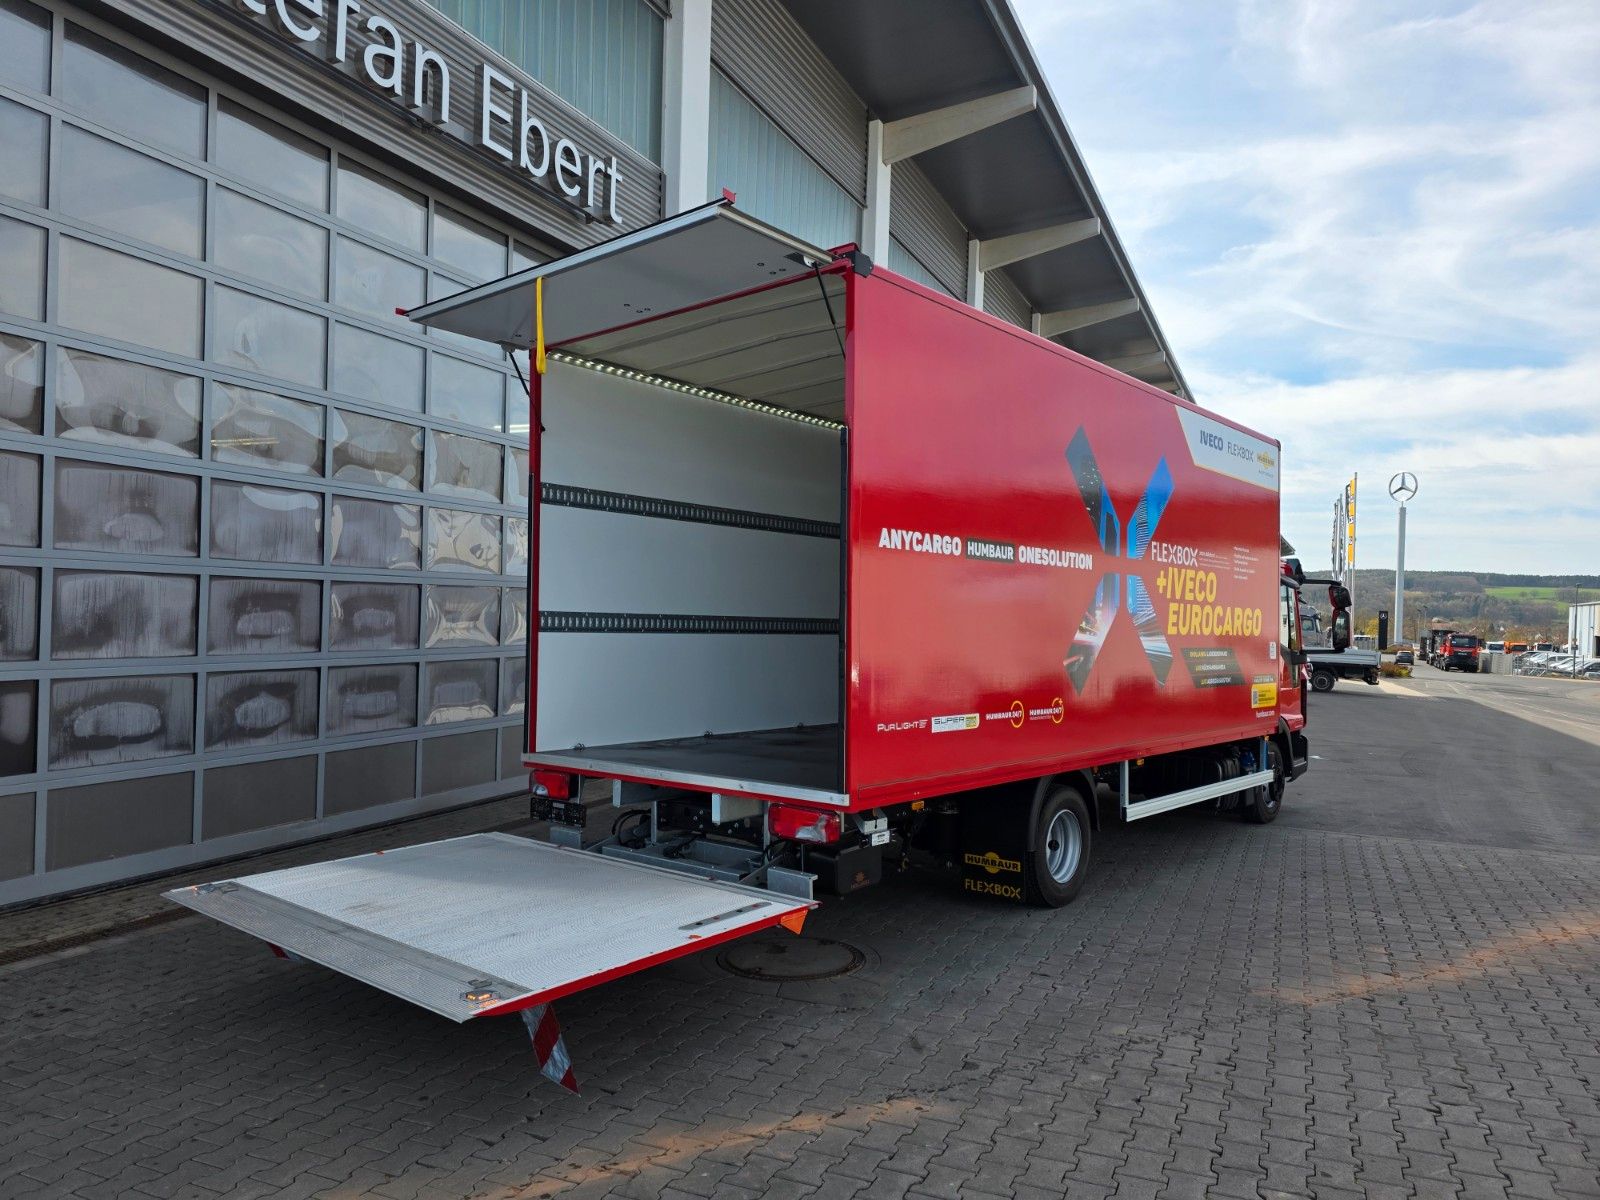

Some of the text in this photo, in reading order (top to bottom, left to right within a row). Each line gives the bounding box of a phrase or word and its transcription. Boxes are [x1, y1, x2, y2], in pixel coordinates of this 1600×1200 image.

[242, 0, 623, 224] efan Ebert
[1200, 430, 1224, 451] IVECO
[1227, 441, 1254, 463] FLEXBOX
[879, 528, 1093, 570] ANYCARGO HUMBAUR ONESOLUTION
[1151, 541, 1199, 567] FLEXBOX
[1157, 566, 1217, 603] +IVECO
[1167, 602, 1262, 636] EUROCARGO
[965, 853, 1020, 872] HUMBAUR
[965, 878, 1022, 900] FLEXBOX
